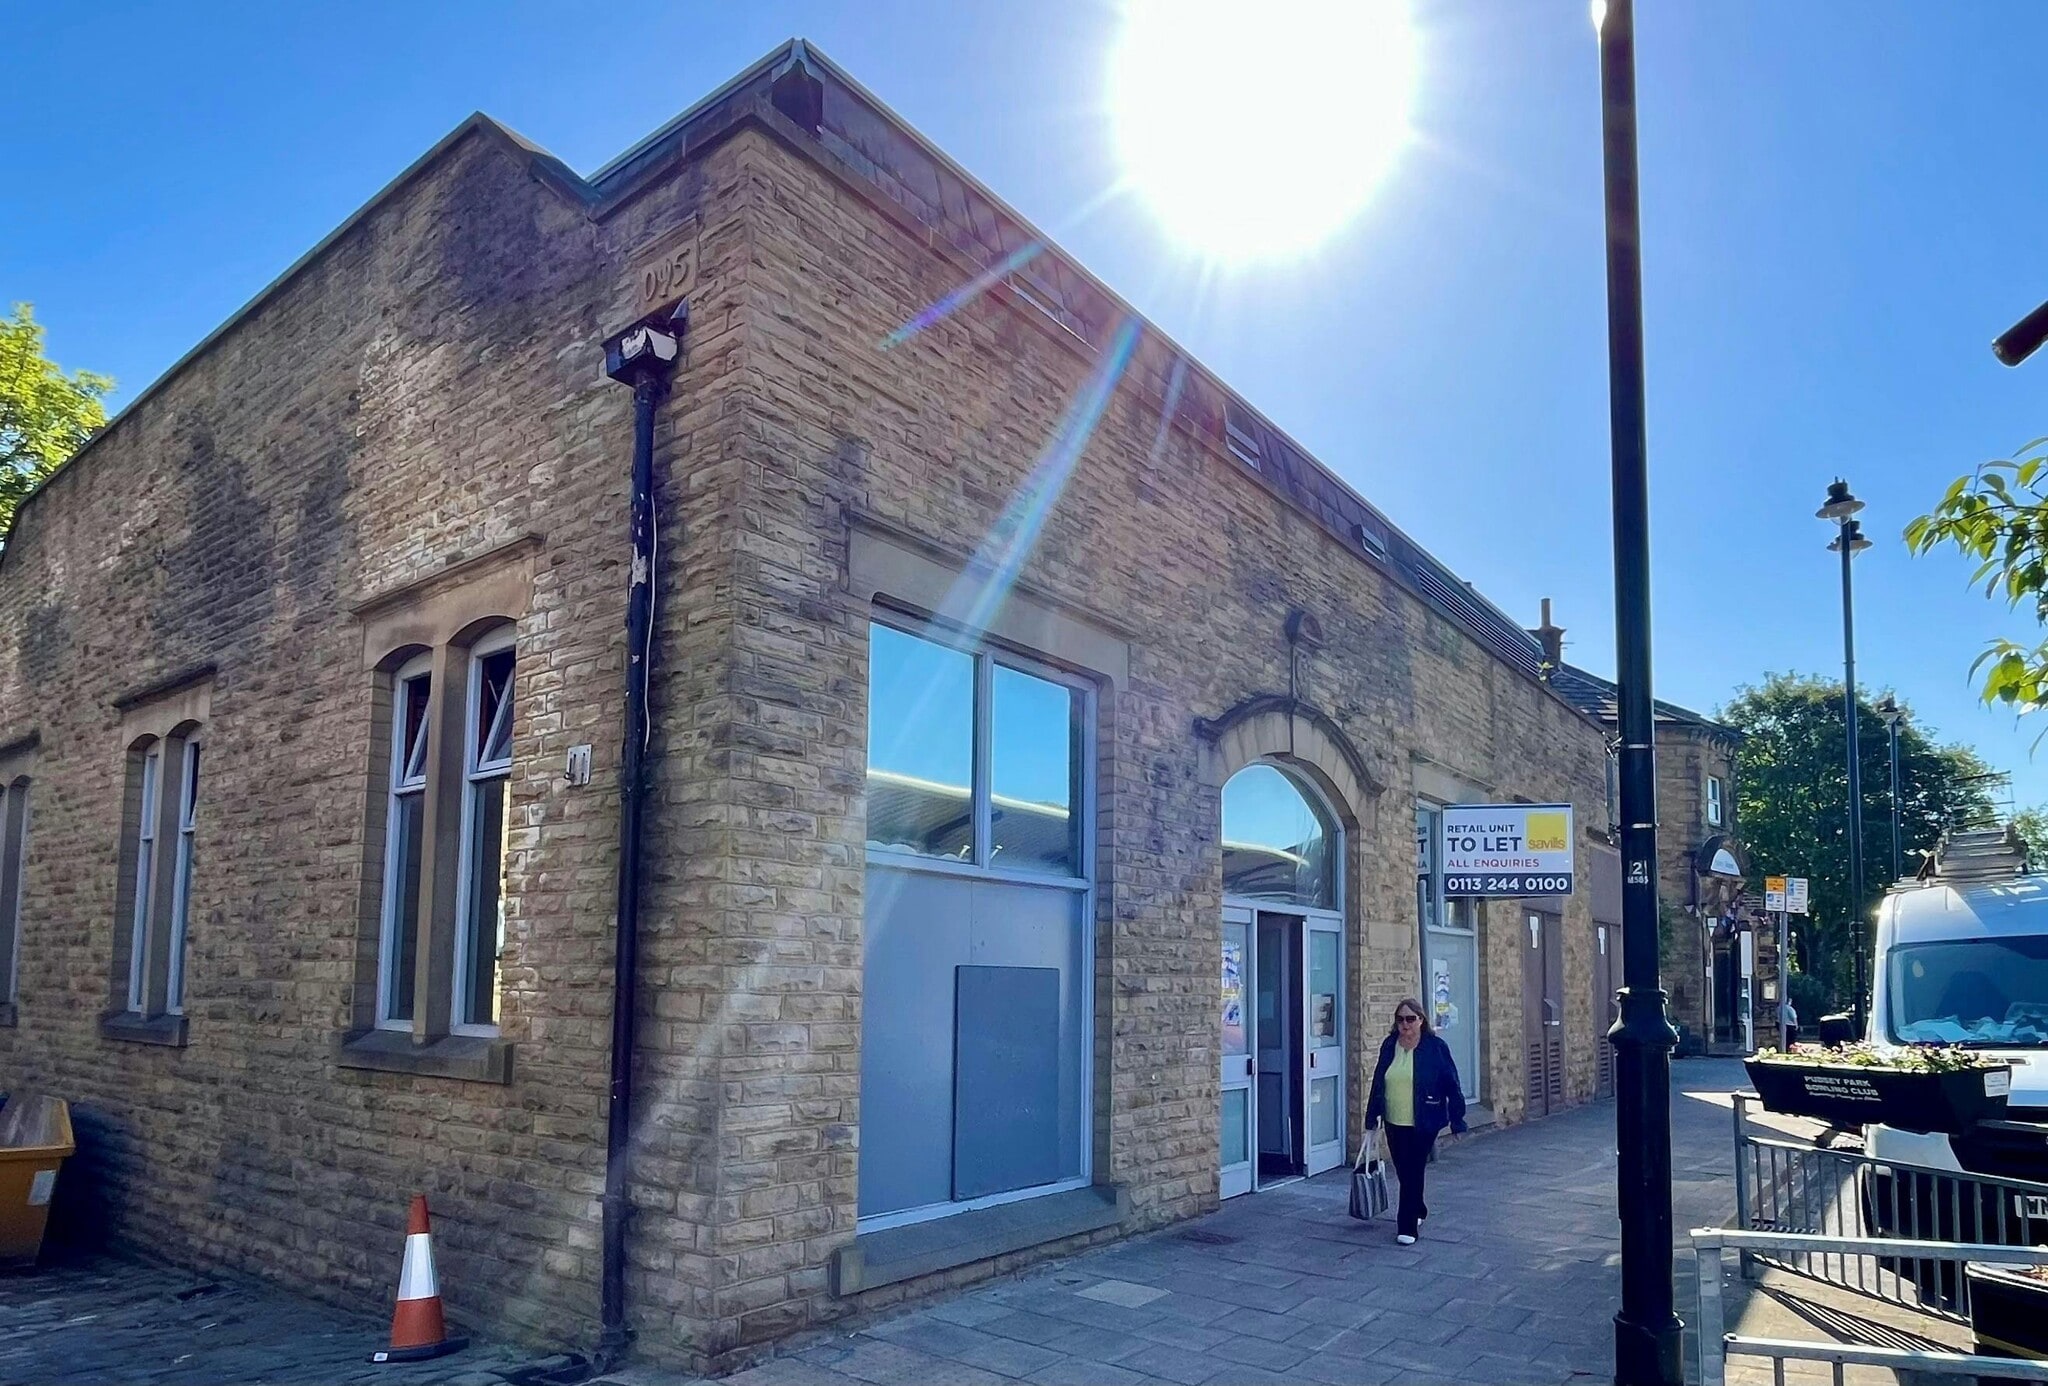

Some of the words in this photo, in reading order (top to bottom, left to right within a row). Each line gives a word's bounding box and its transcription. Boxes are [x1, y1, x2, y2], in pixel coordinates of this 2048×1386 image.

[1447, 824, 1486, 833] RETAIL
[1489, 824, 1515, 833] UNIT
[1446, 836, 1476, 852] TO
[1483, 836, 1522, 852] LET
[1528, 836, 1566, 850] savills
[1447, 858, 1470, 868] ALL
[1473, 858, 1540, 868] ENQUIRIES
[1447, 877, 1481, 890] 0113
[1487, 877, 1520, 890] 244
[1525, 877, 1568, 890] 0100
[1842, 1078, 1871, 1087] PARK
